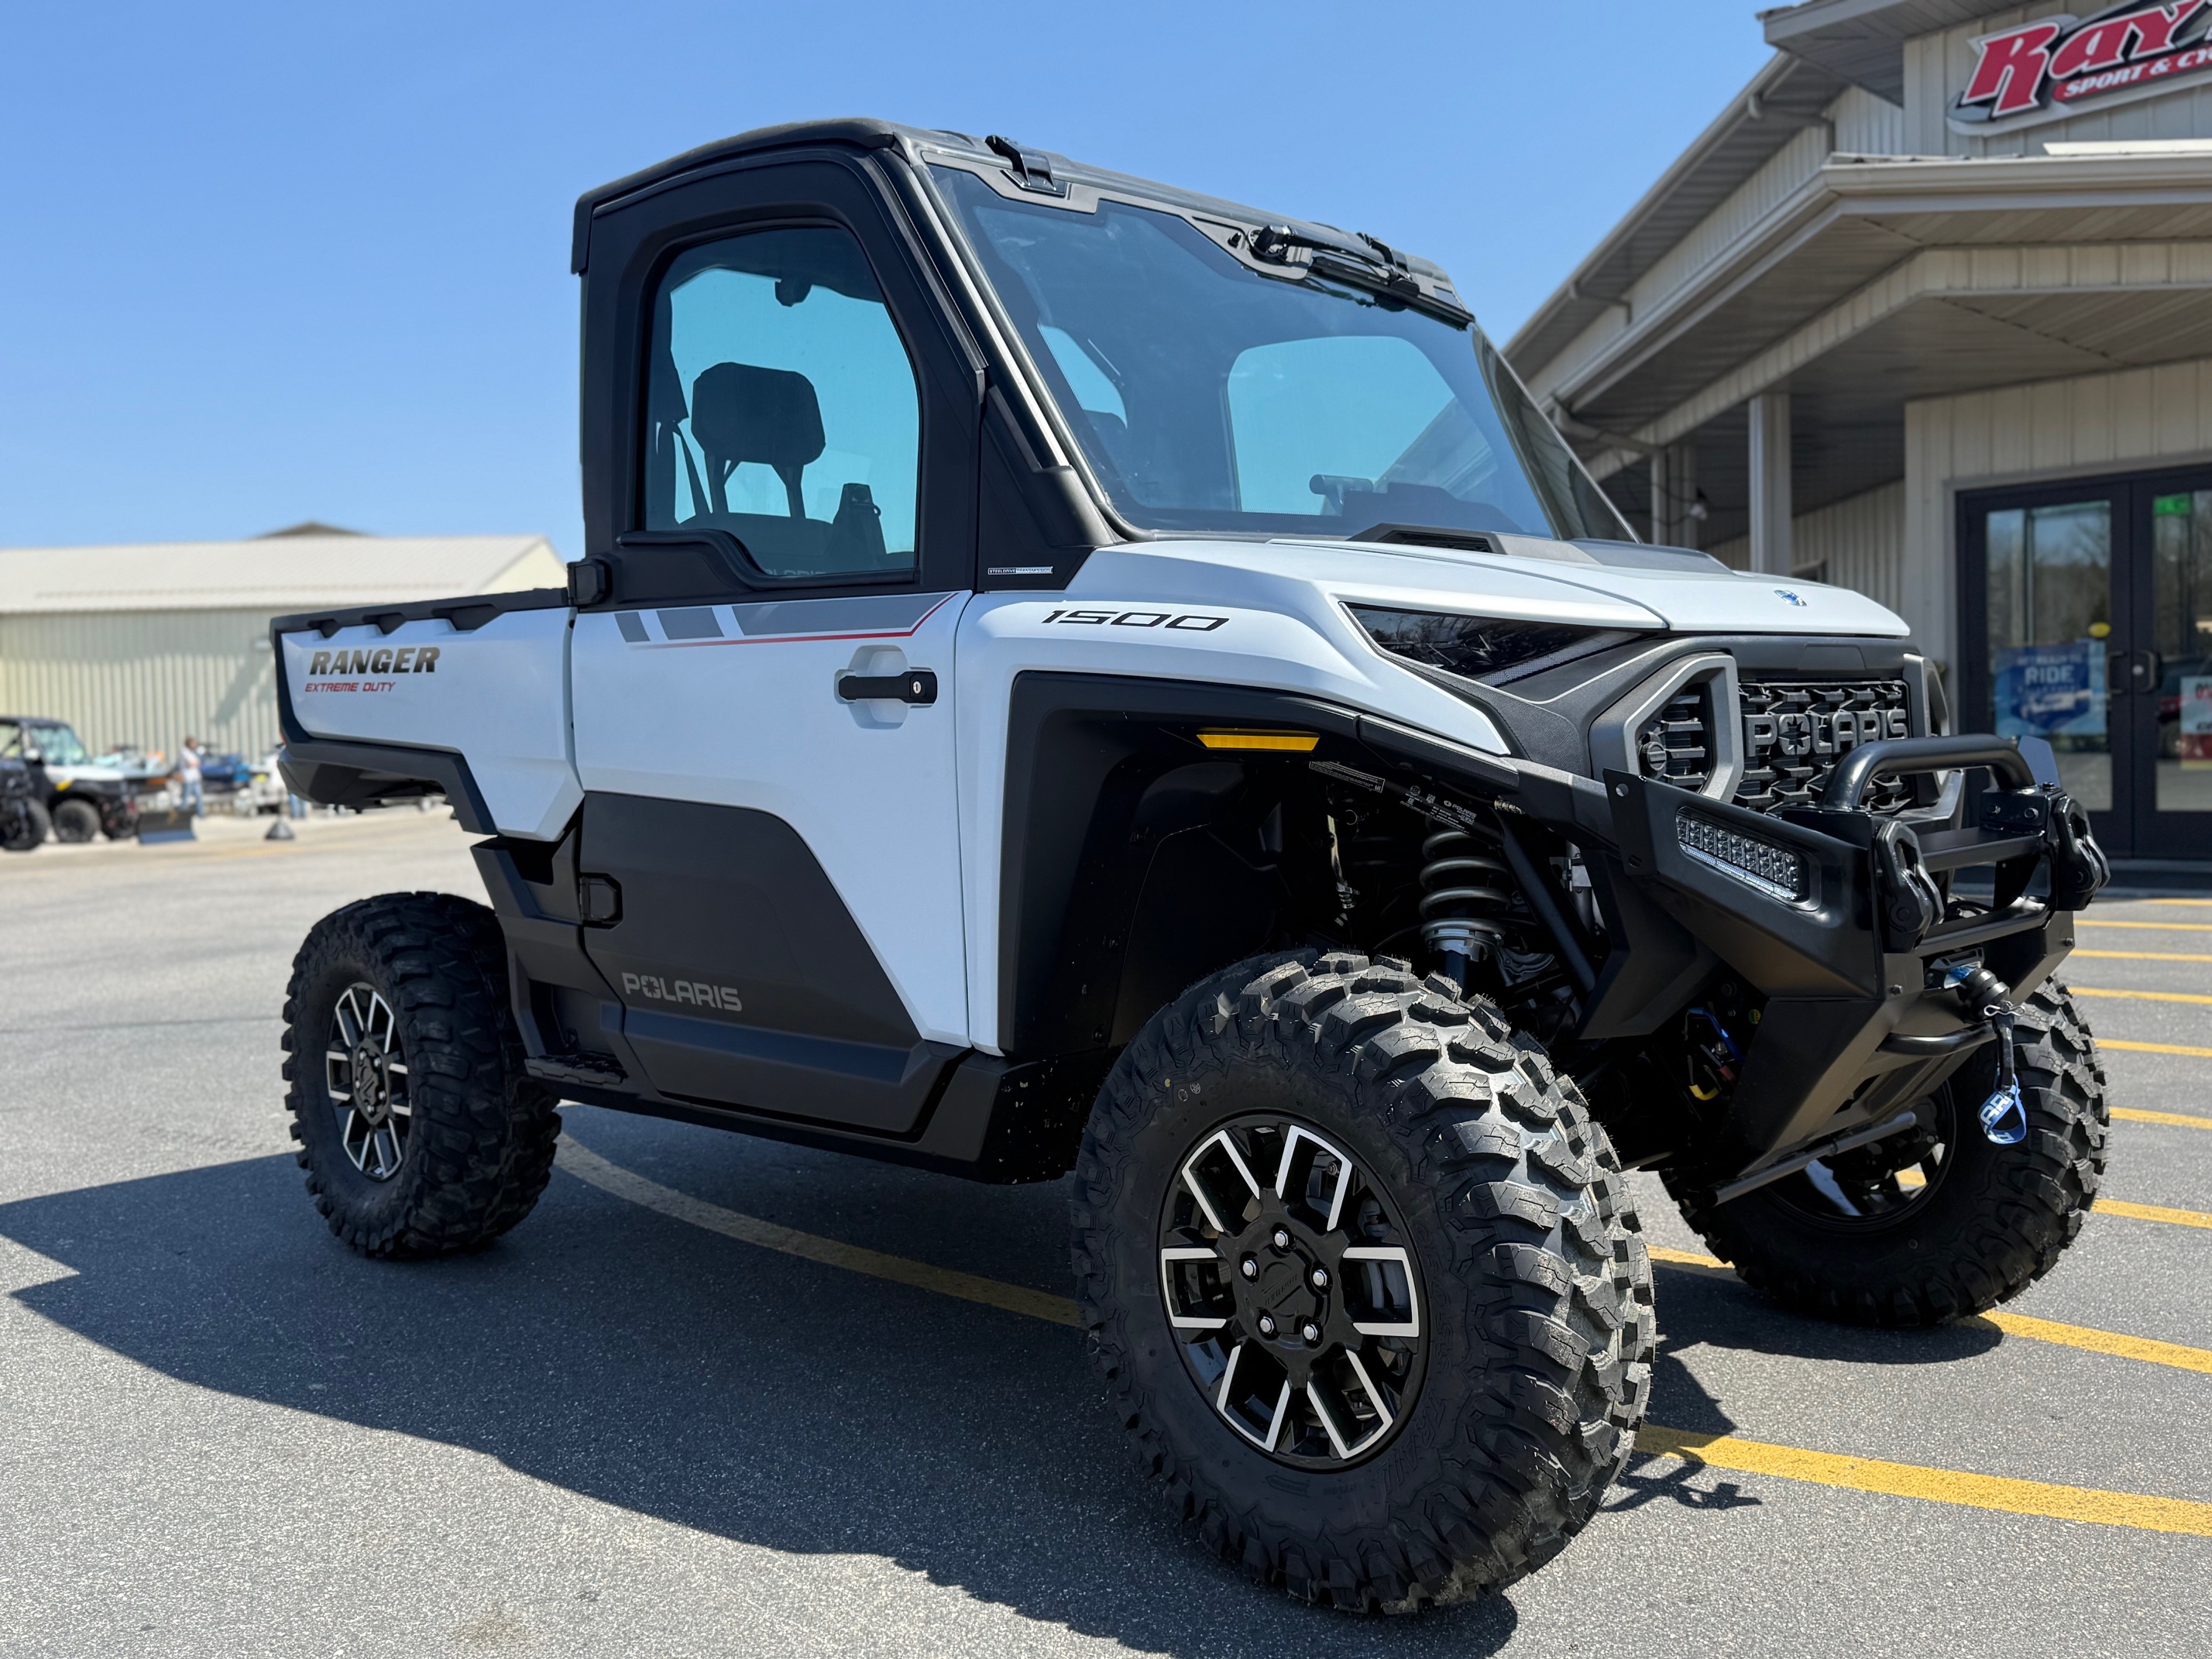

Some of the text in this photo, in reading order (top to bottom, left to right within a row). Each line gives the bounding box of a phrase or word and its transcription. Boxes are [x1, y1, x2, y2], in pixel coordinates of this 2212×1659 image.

[2063, 63, 2148, 97] SPORT
[2149, 57, 2172, 75] &
[1042, 610, 1230, 631] 1500
[310, 647, 441, 675] RANGER
[305, 682, 396, 692] EXTREME DUTY
[2025, 665, 2076, 686] RIDE
[1744, 708, 1908, 757] POLARIS
[621, 972, 743, 1012] POLARIS
